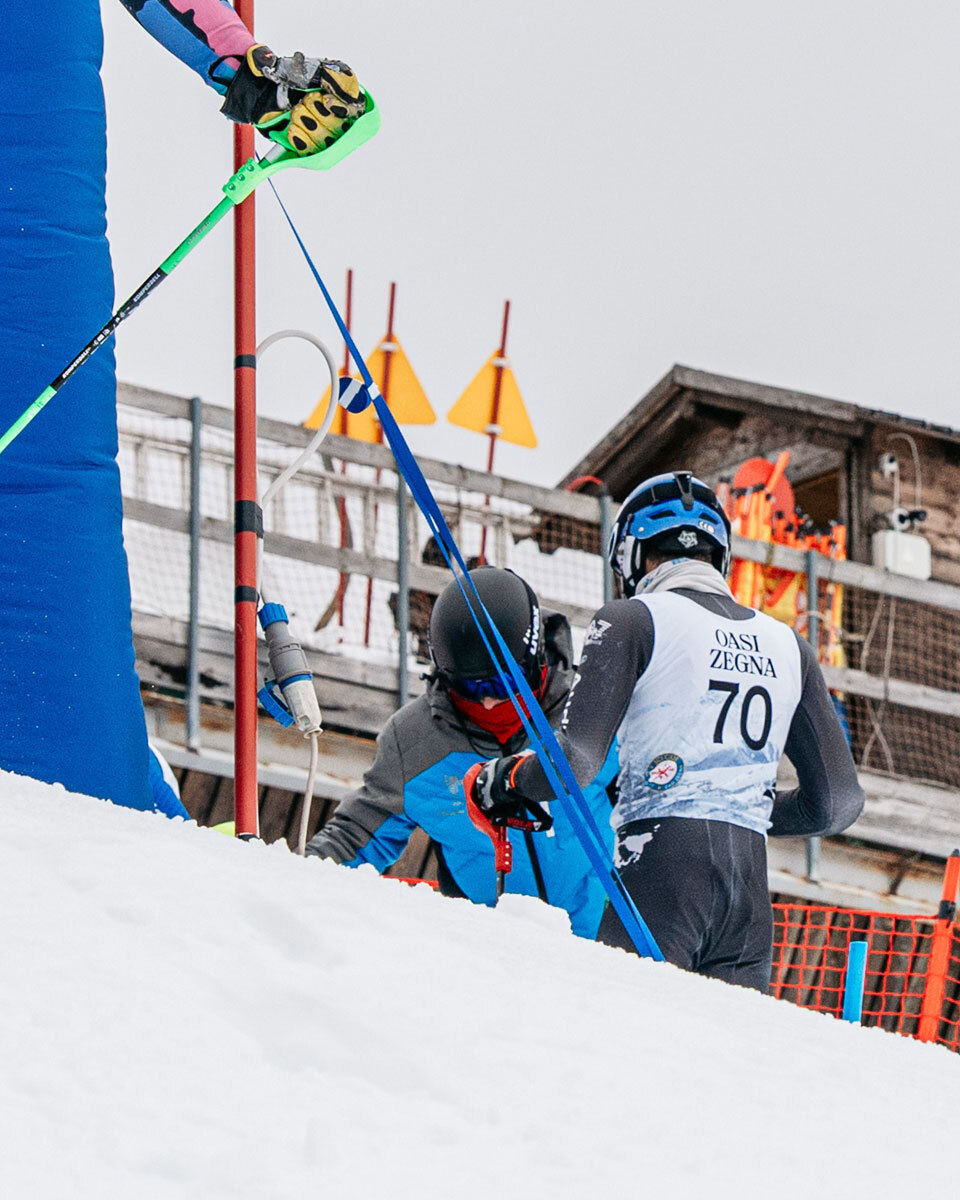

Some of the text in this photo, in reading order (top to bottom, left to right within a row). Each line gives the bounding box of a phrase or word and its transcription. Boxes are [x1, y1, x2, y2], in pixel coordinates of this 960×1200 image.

[714, 628, 760, 652] OASI
[709, 648, 777, 679] ZEGNA
[708, 678, 773, 751] 70
